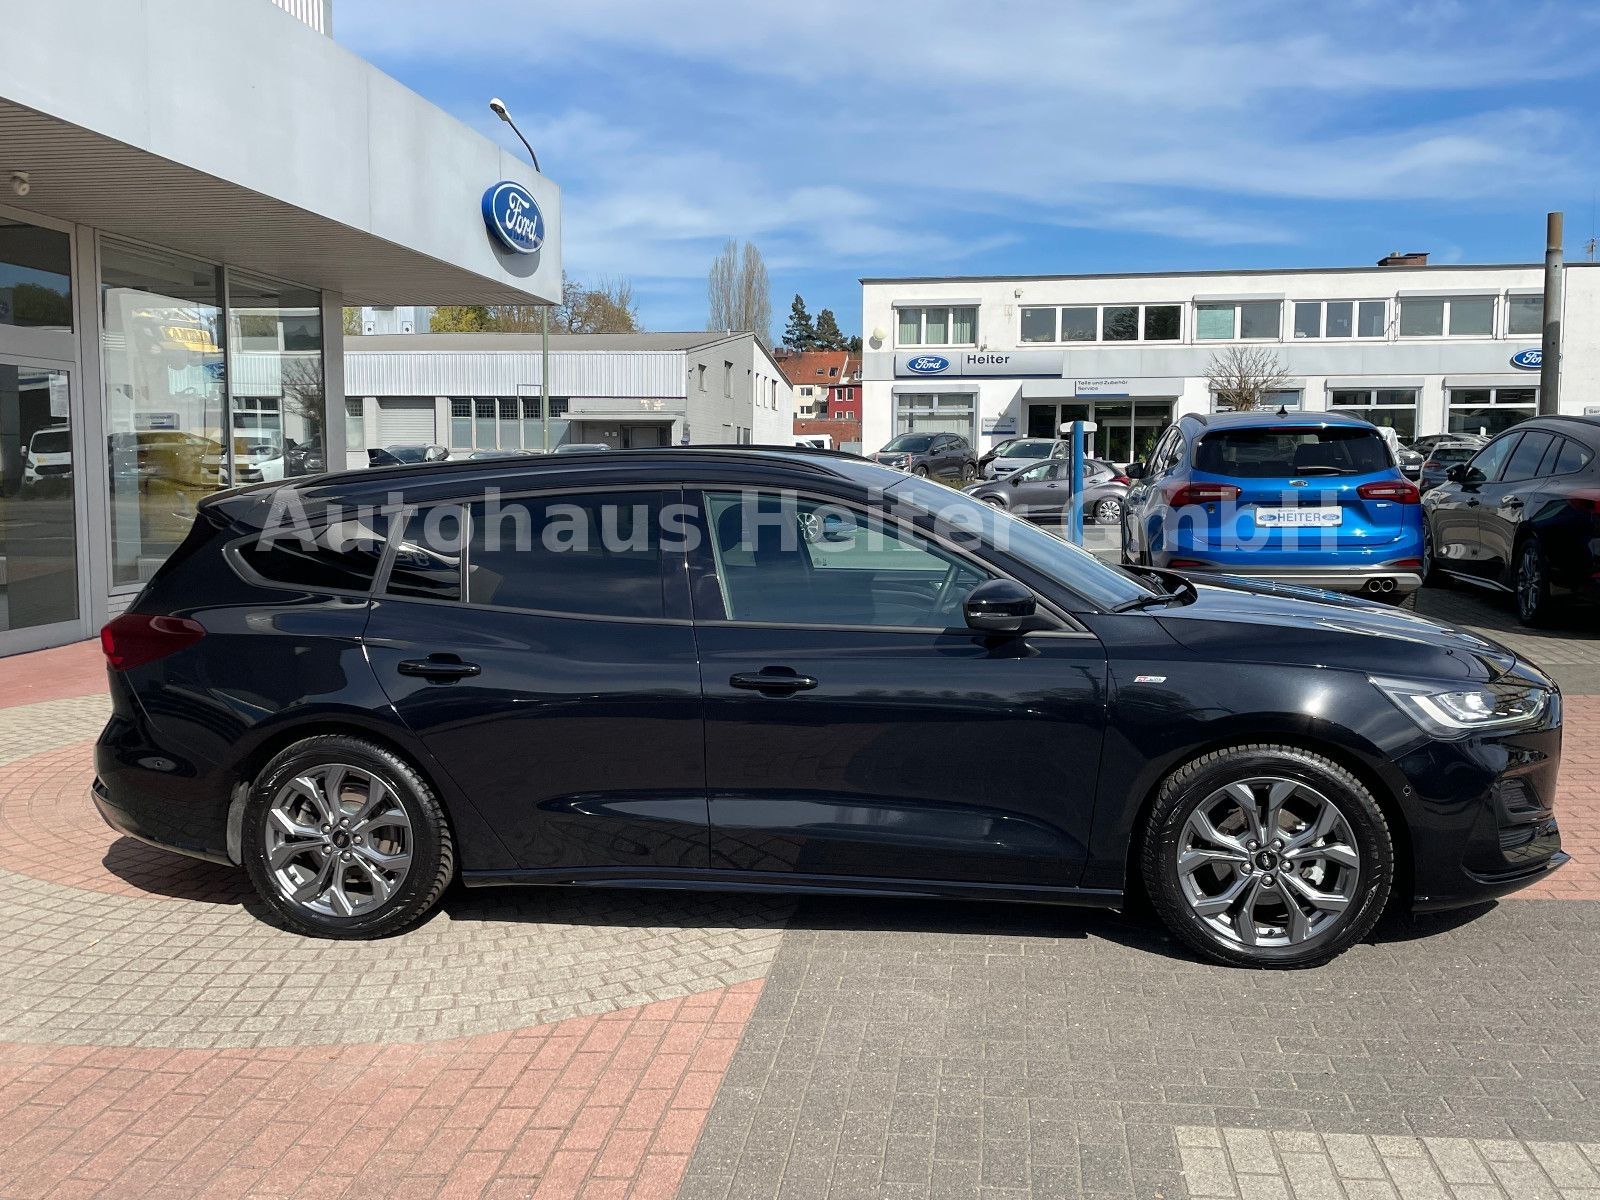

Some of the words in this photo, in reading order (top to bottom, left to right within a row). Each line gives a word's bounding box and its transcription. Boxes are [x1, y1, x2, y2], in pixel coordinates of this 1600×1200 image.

[505, 192, 537, 241] Ford
[915, 357, 942, 369] Ford
[966, 354, 1010, 364] Heiter
[1522, 351, 1542, 364] For
[1277, 512, 1321, 522] HEITER
